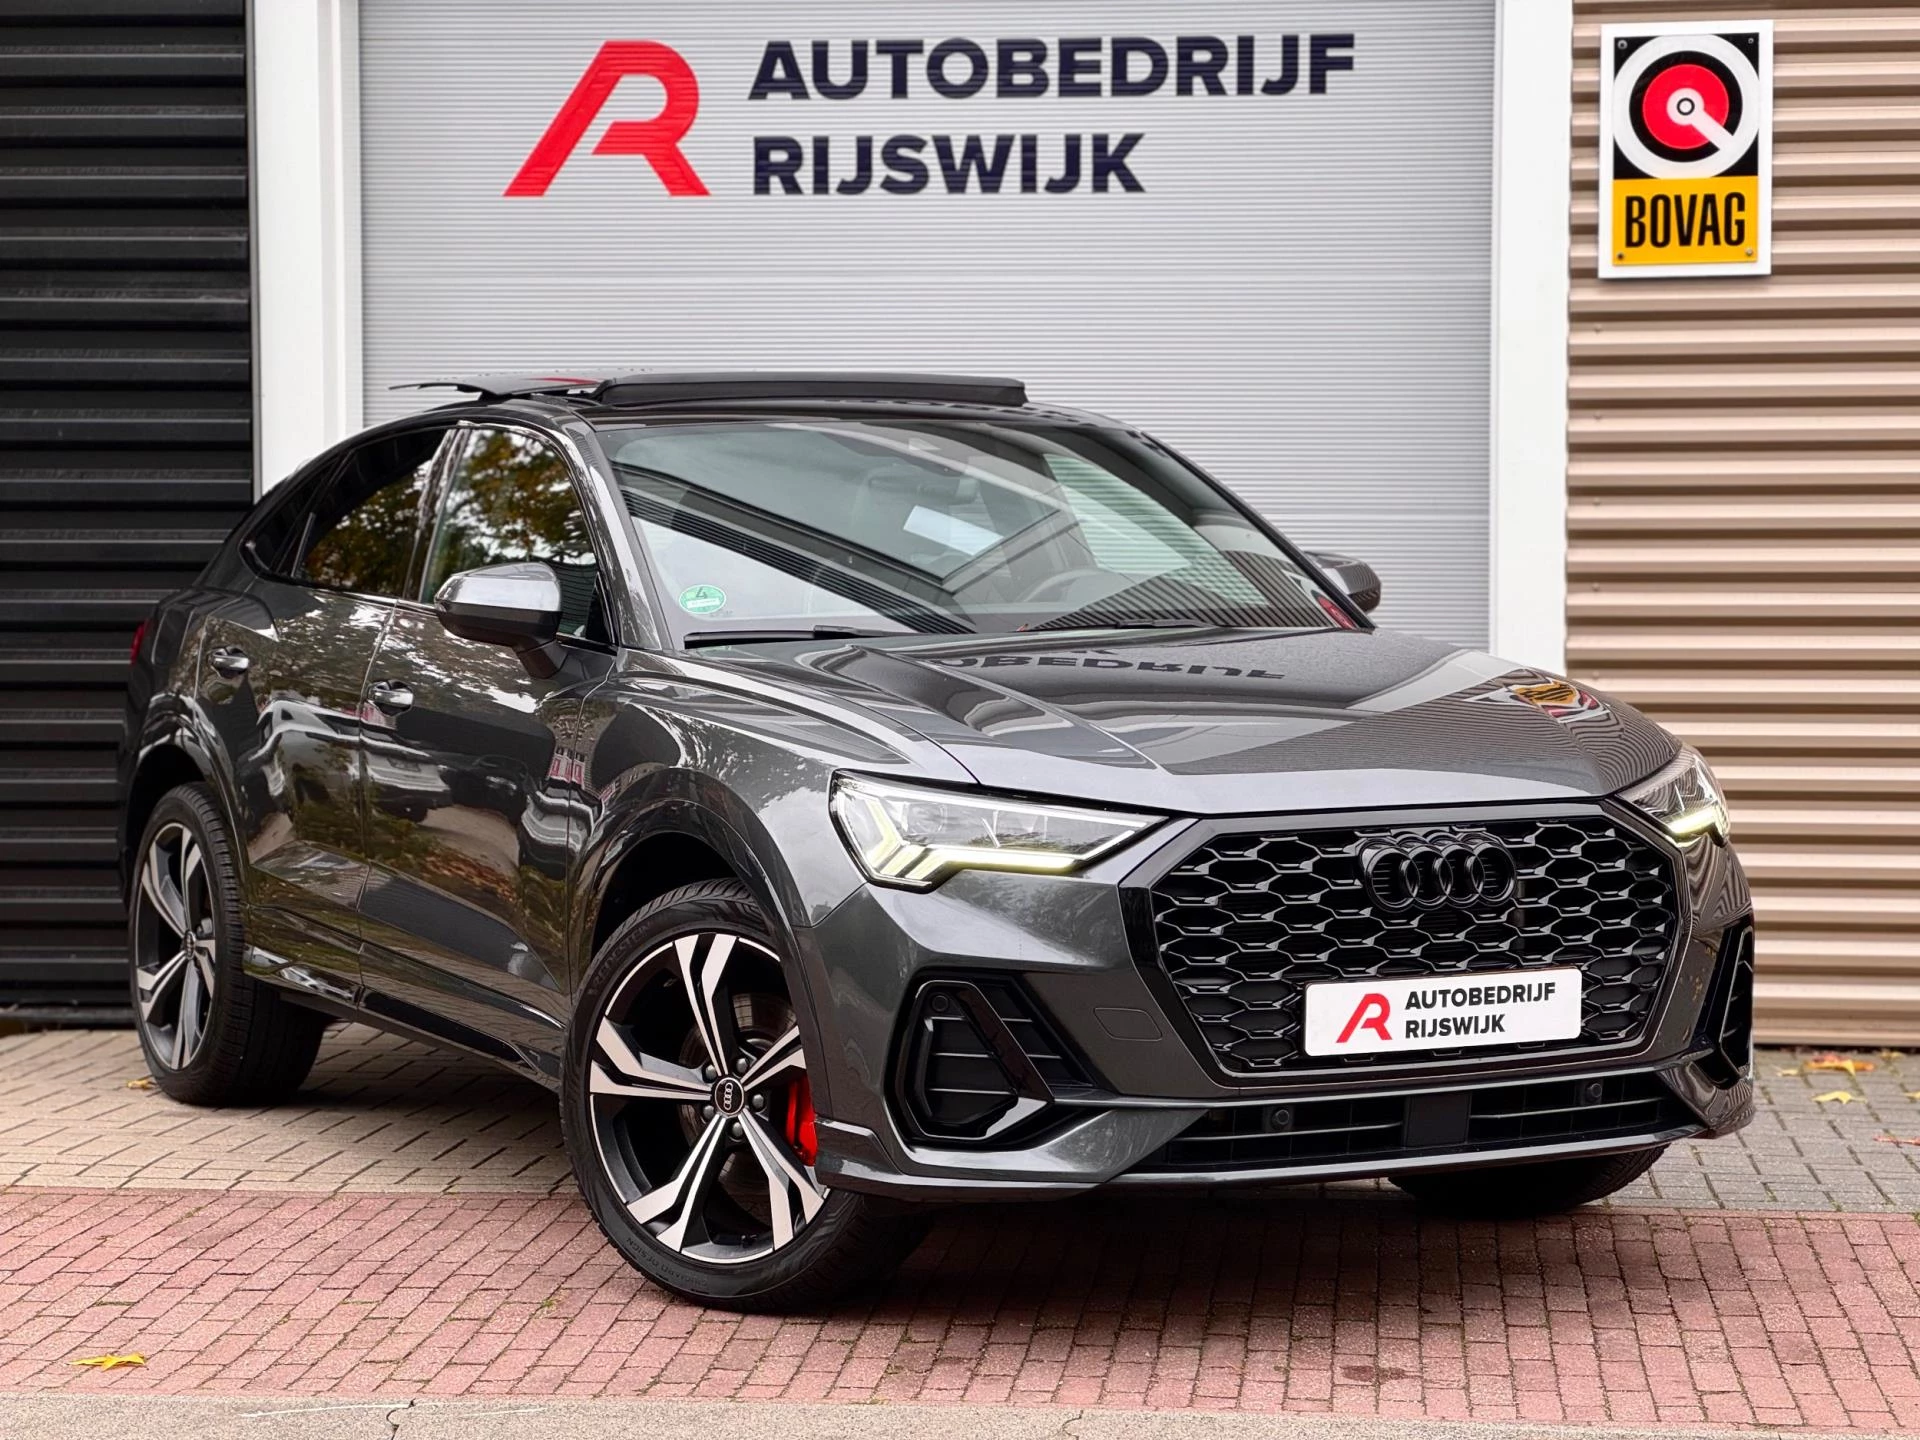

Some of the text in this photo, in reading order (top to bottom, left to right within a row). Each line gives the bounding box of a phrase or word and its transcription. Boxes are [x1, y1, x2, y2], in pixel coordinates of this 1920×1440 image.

[748, 33, 1355, 100] AUTOBEDRIJF
[753, 132, 1146, 196] RIJSWIJK
[1625, 191, 1746, 248] BOVAG
[1404, 982, 1556, 1010] AUTOBEDRIJF
[1405, 1014, 1506, 1039] RIJSWIJK
